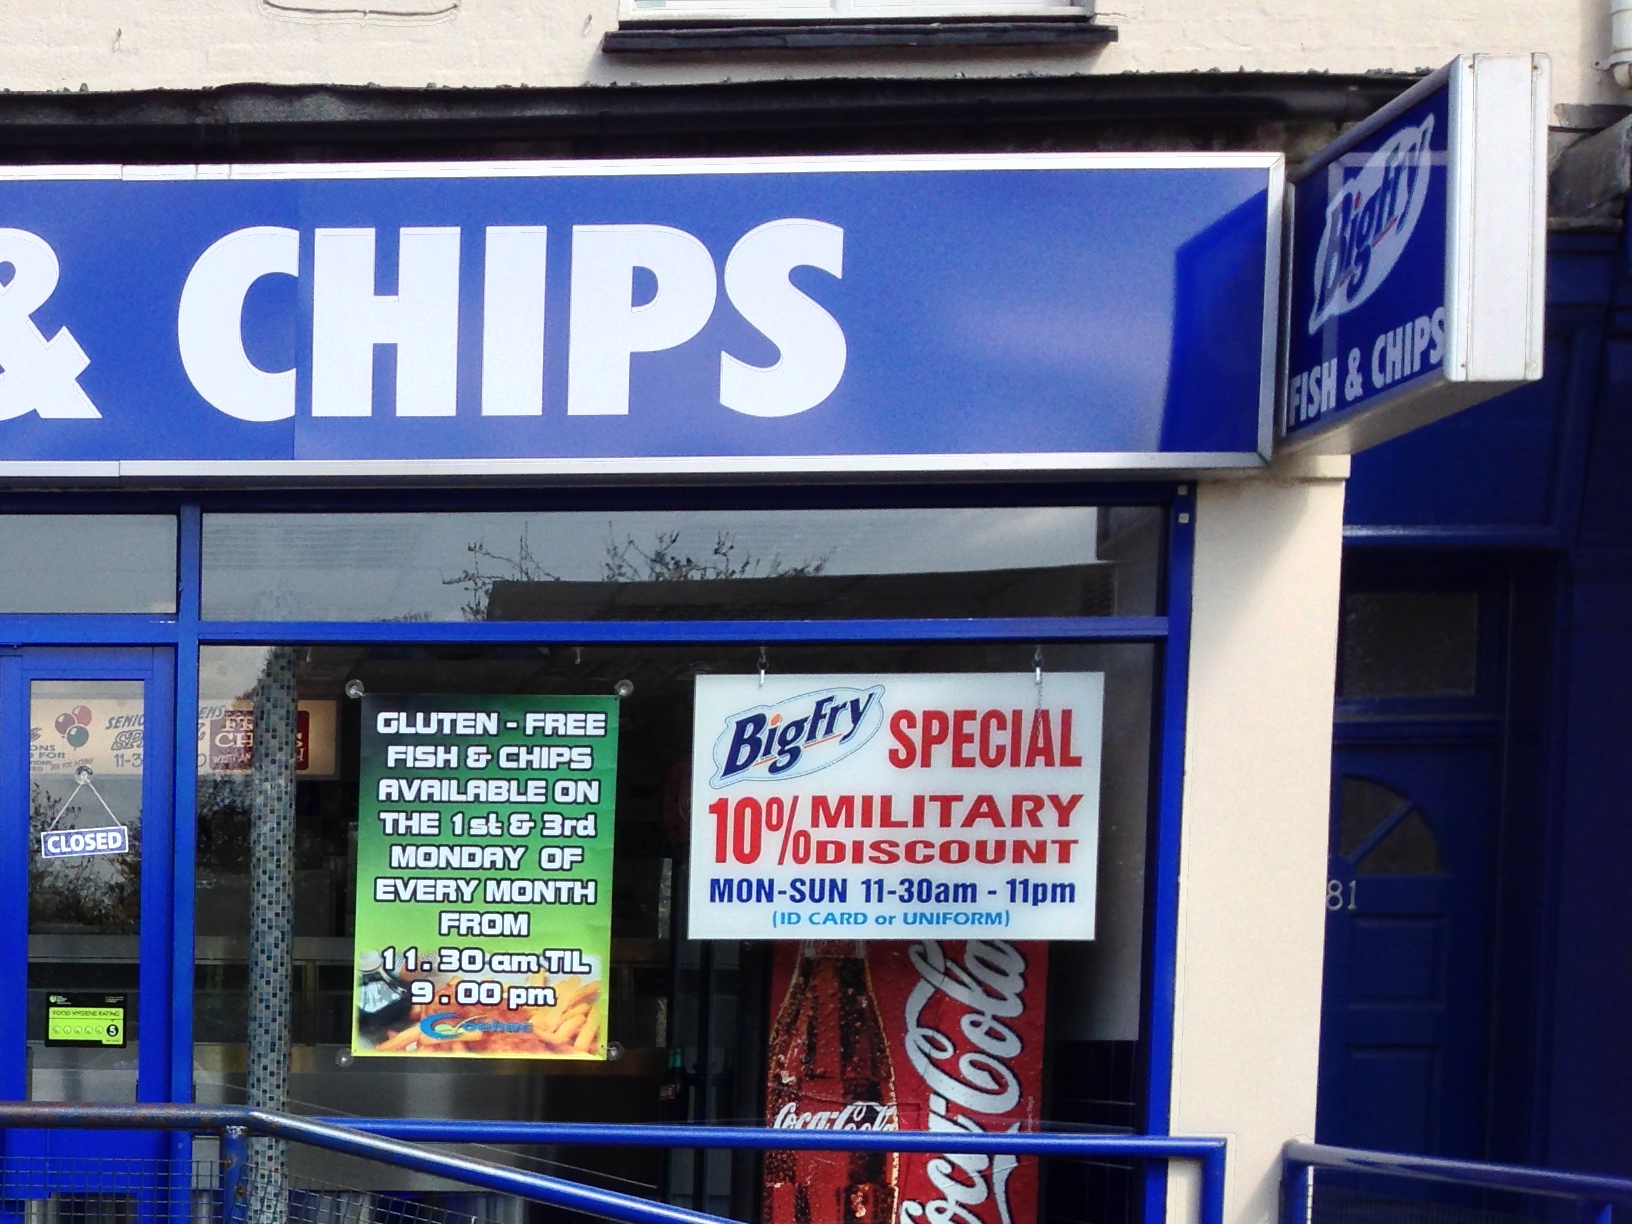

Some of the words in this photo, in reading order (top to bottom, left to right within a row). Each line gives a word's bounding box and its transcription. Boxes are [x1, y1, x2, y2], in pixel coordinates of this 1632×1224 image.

[178, 217, 847, 422] CHIPS
[1289, 358, 1338, 426] FISH
[1344, 347, 1364, 402] &
[1371, 307, 1447, 389] CHIPS
[376, 711, 499, 735] GLUTEN
[524, 712, 606, 736] FREE
[721, 692, 876, 774] BigFry
[888, 709, 1083, 769] SPECIAL
[387, 745, 459, 769] FISH
[466, 745, 492, 769] &
[499, 746, 593, 770] CHIPS
[377, 778, 547, 803] AVAILABLE
[553, 780, 600, 803] ON
[378, 811, 440, 835] THE
[452, 812, 503, 836] 1st
[508, 812, 534, 837] &
[542, 813, 596, 838] 3rd
[708, 795, 811, 866] 10%
[811, 794, 1084, 829] MILITARY
[46, 831, 122, 854] CLOSED
[815, 839, 1079, 865] DISCOUNT
[390, 844, 525, 870] MONDAY
[540, 846, 583, 871] OF
[375, 877, 479, 902] EVERY
[485, 879, 597, 904] MONTH
[710, 878, 848, 904] MON-SUN
[861, 878, 977, 904] 11-30am
[1006, 878, 1076, 907] 11pm
[439, 912, 529, 936] FROM
[773, 911, 802, 928] (ID
[808, 912, 868, 927] CARD
[874, 915, 897, 927] or
[902, 910, 1010, 928] UNIFORM)
[543, 949, 591, 974] TIL
[508, 986, 556, 1009] pm
